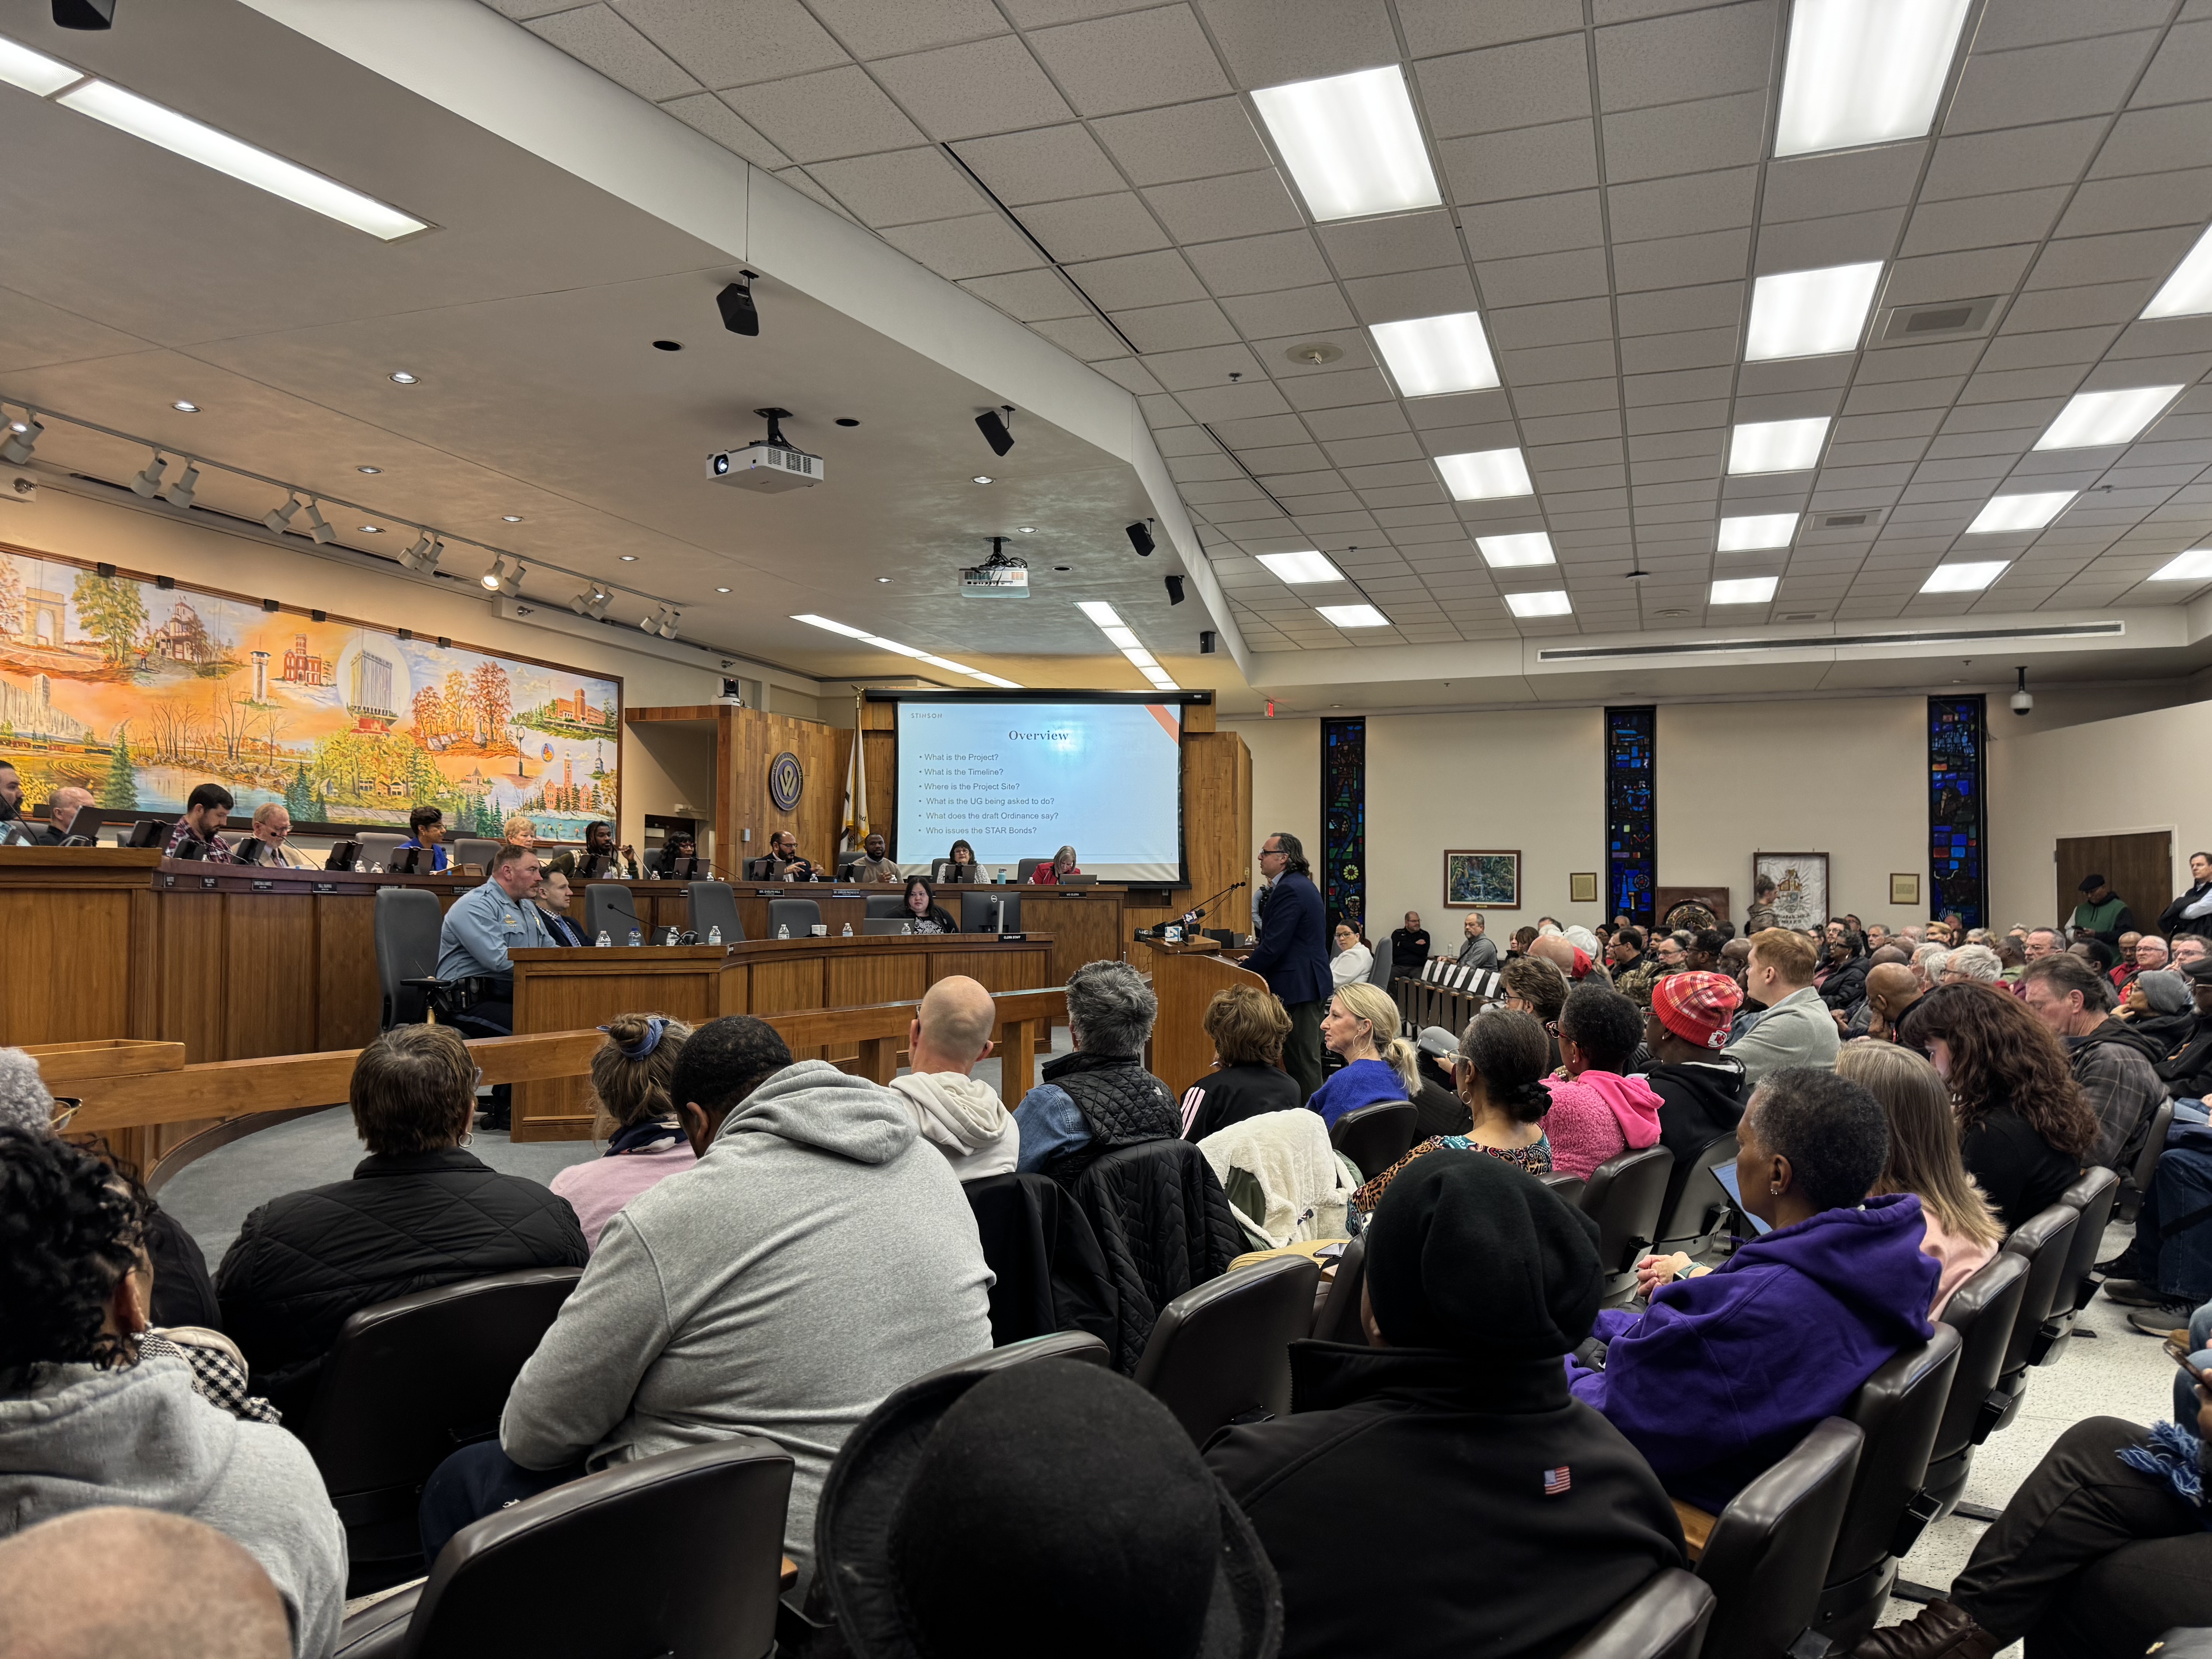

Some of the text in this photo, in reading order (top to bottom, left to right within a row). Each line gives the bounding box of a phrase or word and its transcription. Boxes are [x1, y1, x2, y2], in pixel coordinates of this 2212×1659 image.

[1008, 730, 1069, 740] Overview
[968, 754, 999, 762] Project?
[973, 783, 999, 792] Project
[985, 797, 1005, 806] being
[1041, 812, 1059, 821] say?
[1185, 914, 1193, 922] 4
